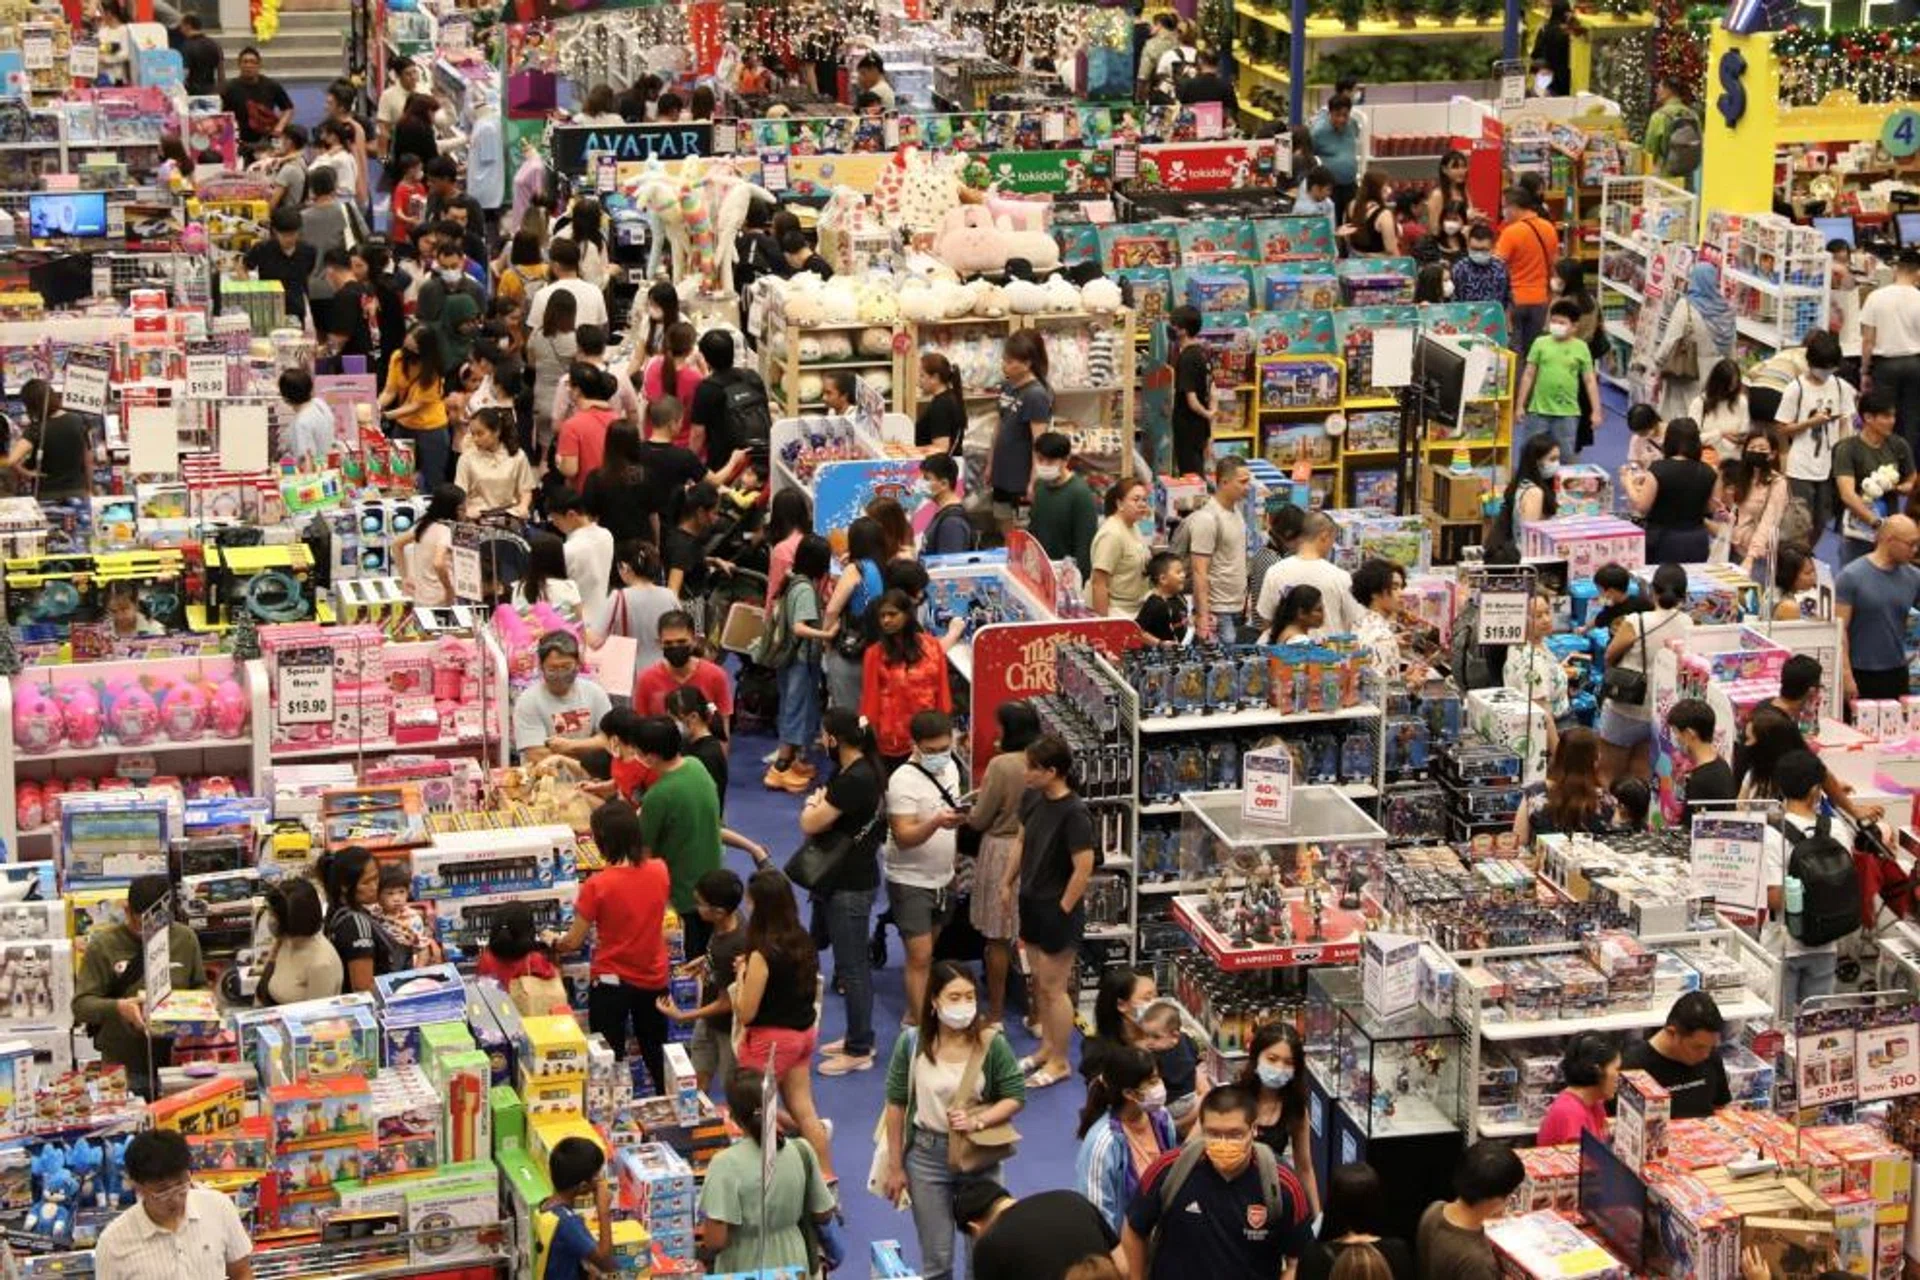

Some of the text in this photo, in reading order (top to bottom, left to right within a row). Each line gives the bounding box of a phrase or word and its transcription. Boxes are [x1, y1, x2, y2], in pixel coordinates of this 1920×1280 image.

[1893, 116, 1915, 145] 4
[584, 131, 700, 160] AVATAR
[1017, 170, 1064, 183] tokidoki
[1188, 168, 1232, 180] tokidoki
[1483, 625, 1522, 639] $19.90
[286, 667, 326, 676] Special
[292, 679, 319, 687] Buys
[287, 699, 327, 714] $19.90
[1890, 1074, 1917, 1089] $10
[1817, 1083, 1856, 1099] $39.95
